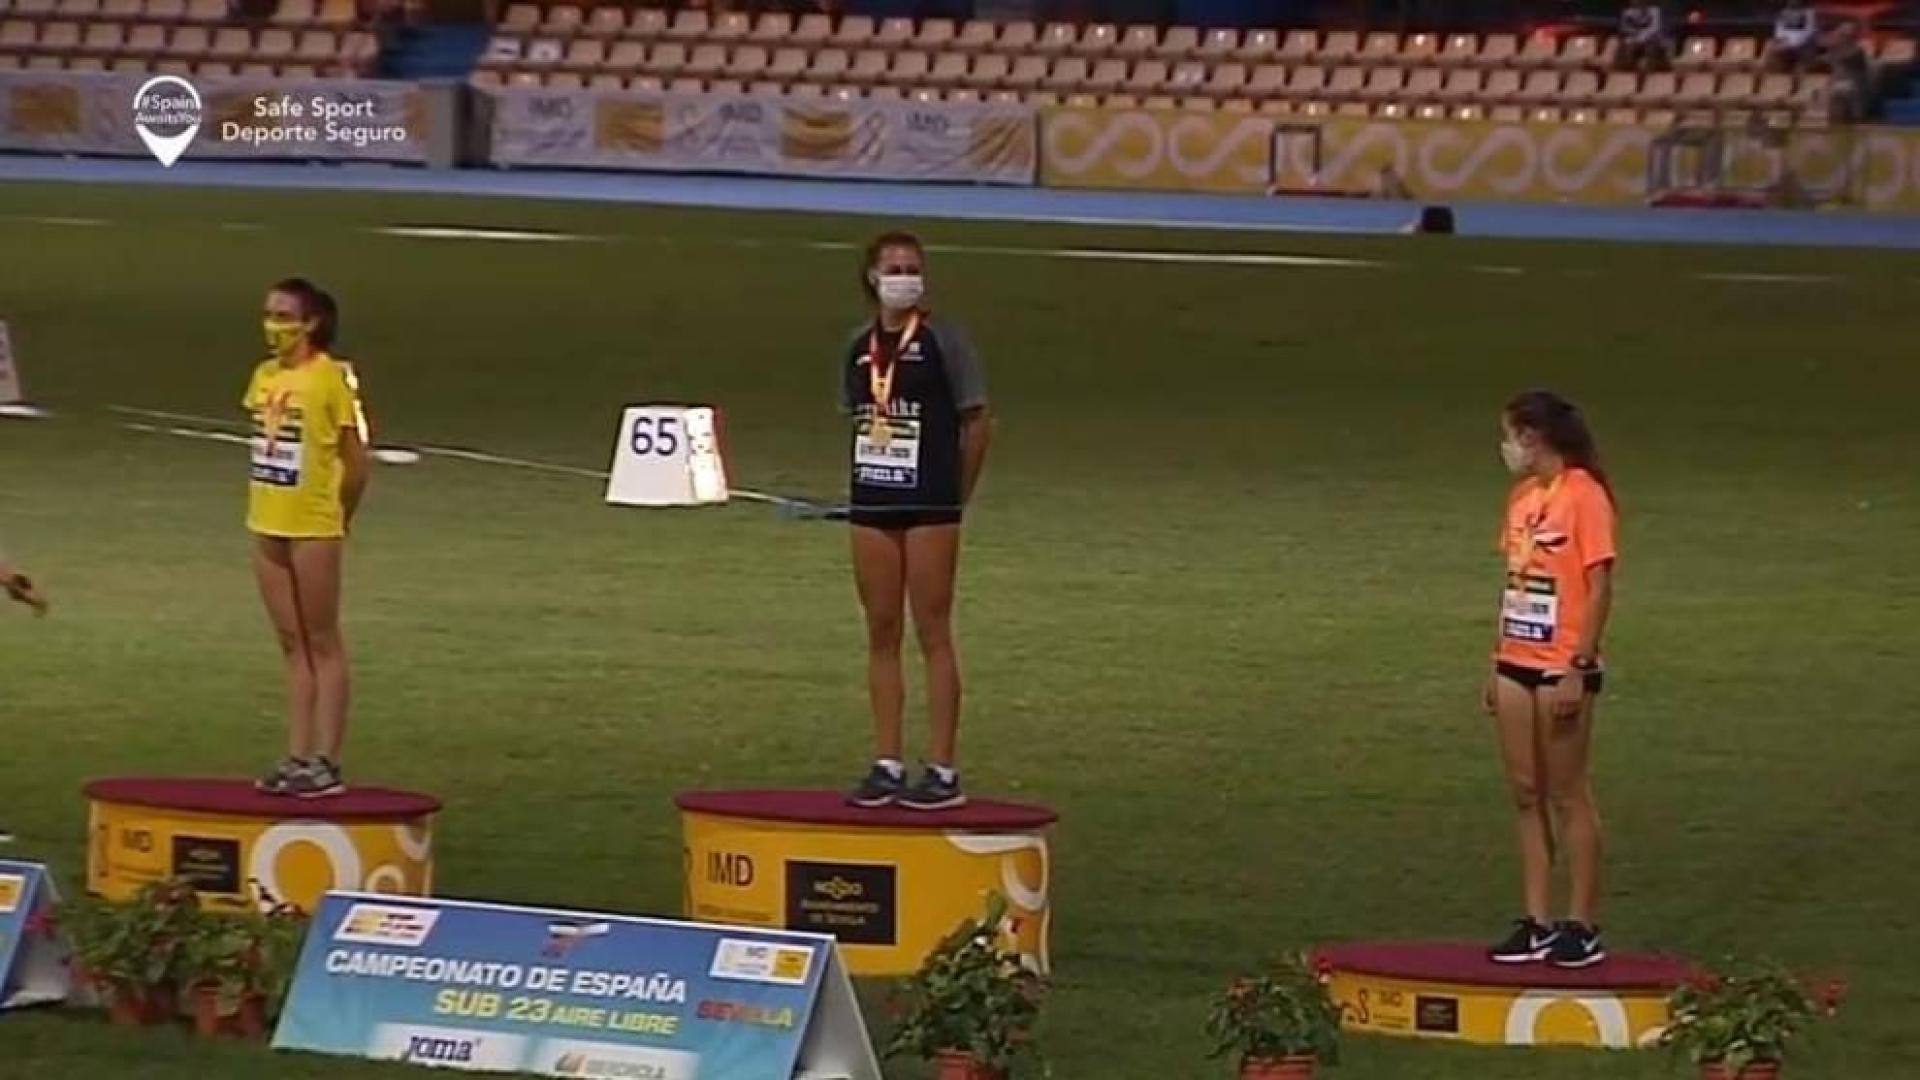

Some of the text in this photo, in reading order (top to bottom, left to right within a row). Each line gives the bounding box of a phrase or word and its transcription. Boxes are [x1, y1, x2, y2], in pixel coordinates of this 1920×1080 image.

[631, 416, 678, 456] 65
[707, 852, 753, 886] IMD
[325, 948, 687, 1004] CAMPEONATO DE ESPAÑA
[433, 988, 681, 1036] SUB 23 AIRE LIBRE
